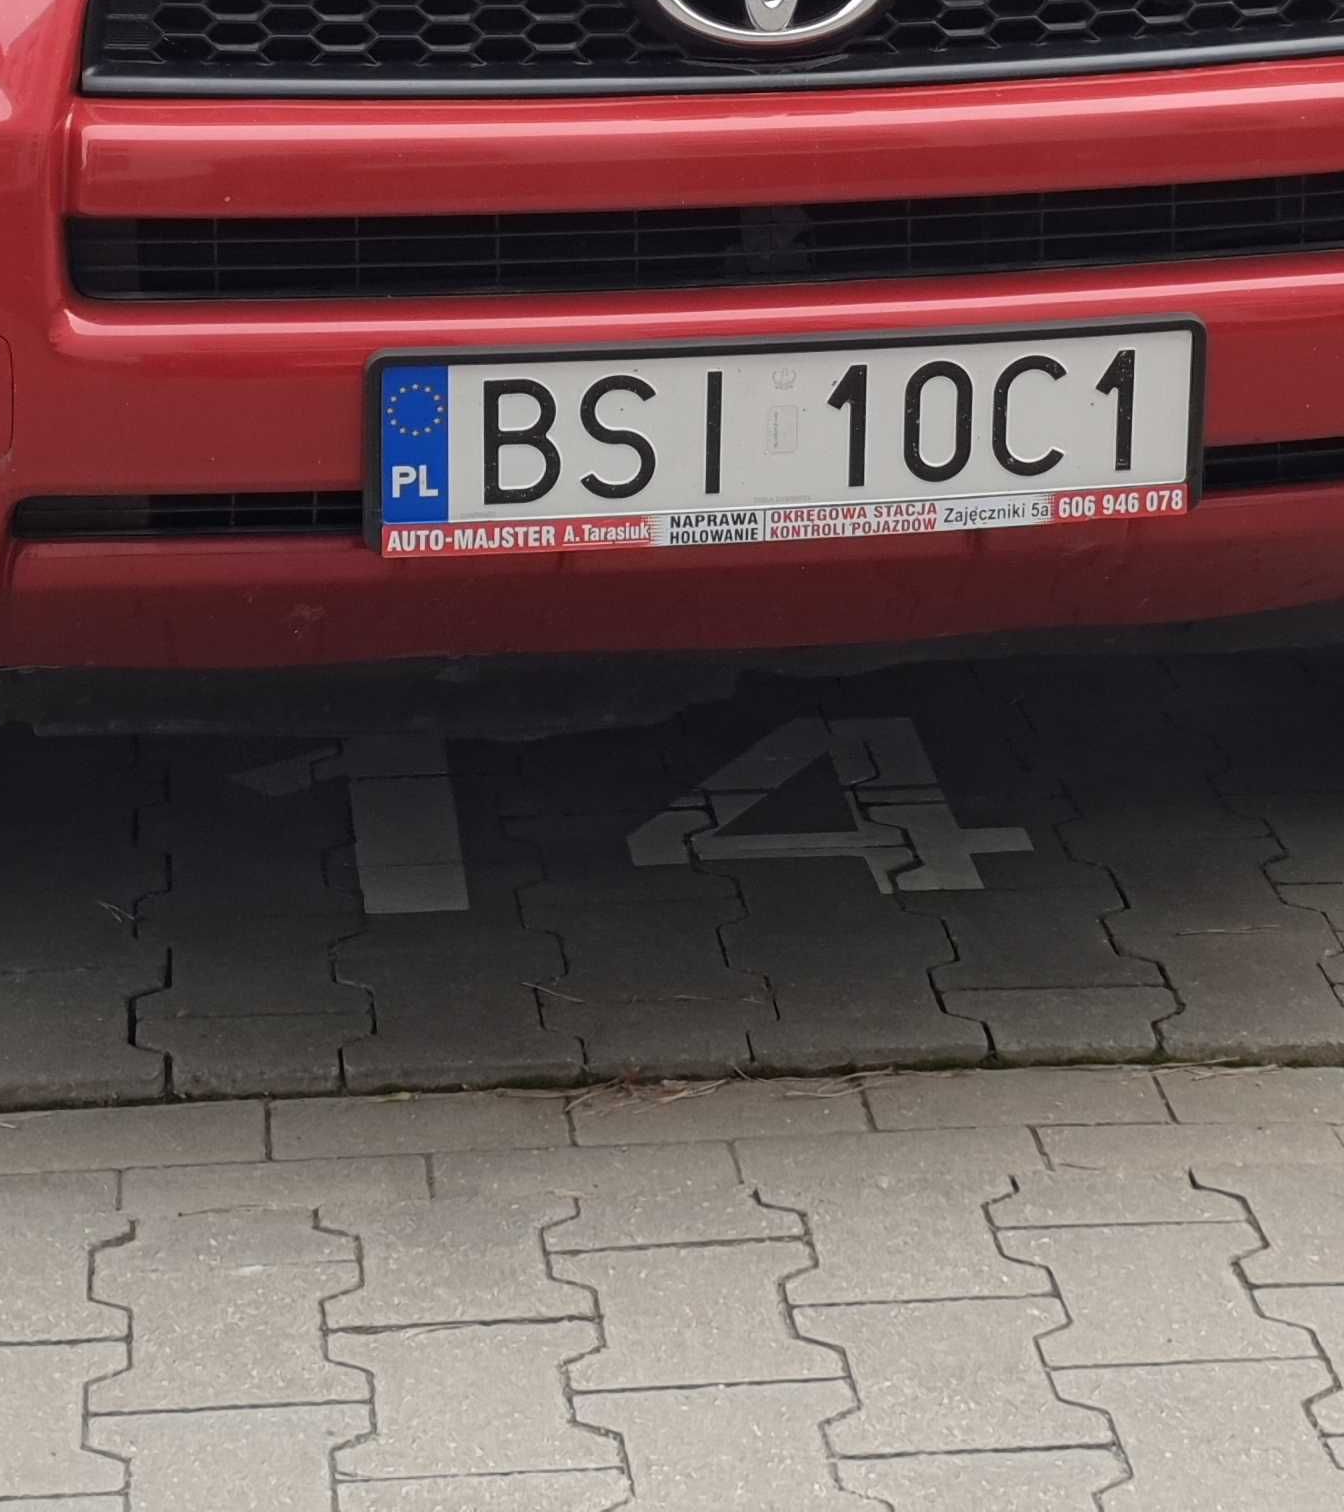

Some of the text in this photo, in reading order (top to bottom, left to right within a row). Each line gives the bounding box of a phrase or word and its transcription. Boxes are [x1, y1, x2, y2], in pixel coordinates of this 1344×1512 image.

[825, 349, 1137, 488] 10C1
[391, 465, 439, 499] PL
[770, 502, 937, 526] OKRĘGOWA STACJA
[943, 502, 1049, 526] Zajęczniki 5a
[1058, 488, 1183, 518] 606 946 078
[670, 511, 758, 529] NAPRAWA
[769, 515, 937, 540] KONTROLI POJAZDÓW
[386, 524, 556, 553] AUTO-MAJSTER
[582, 520, 650, 541] Tarasiuk
[670, 526, 759, 545] HOLOWANIE
